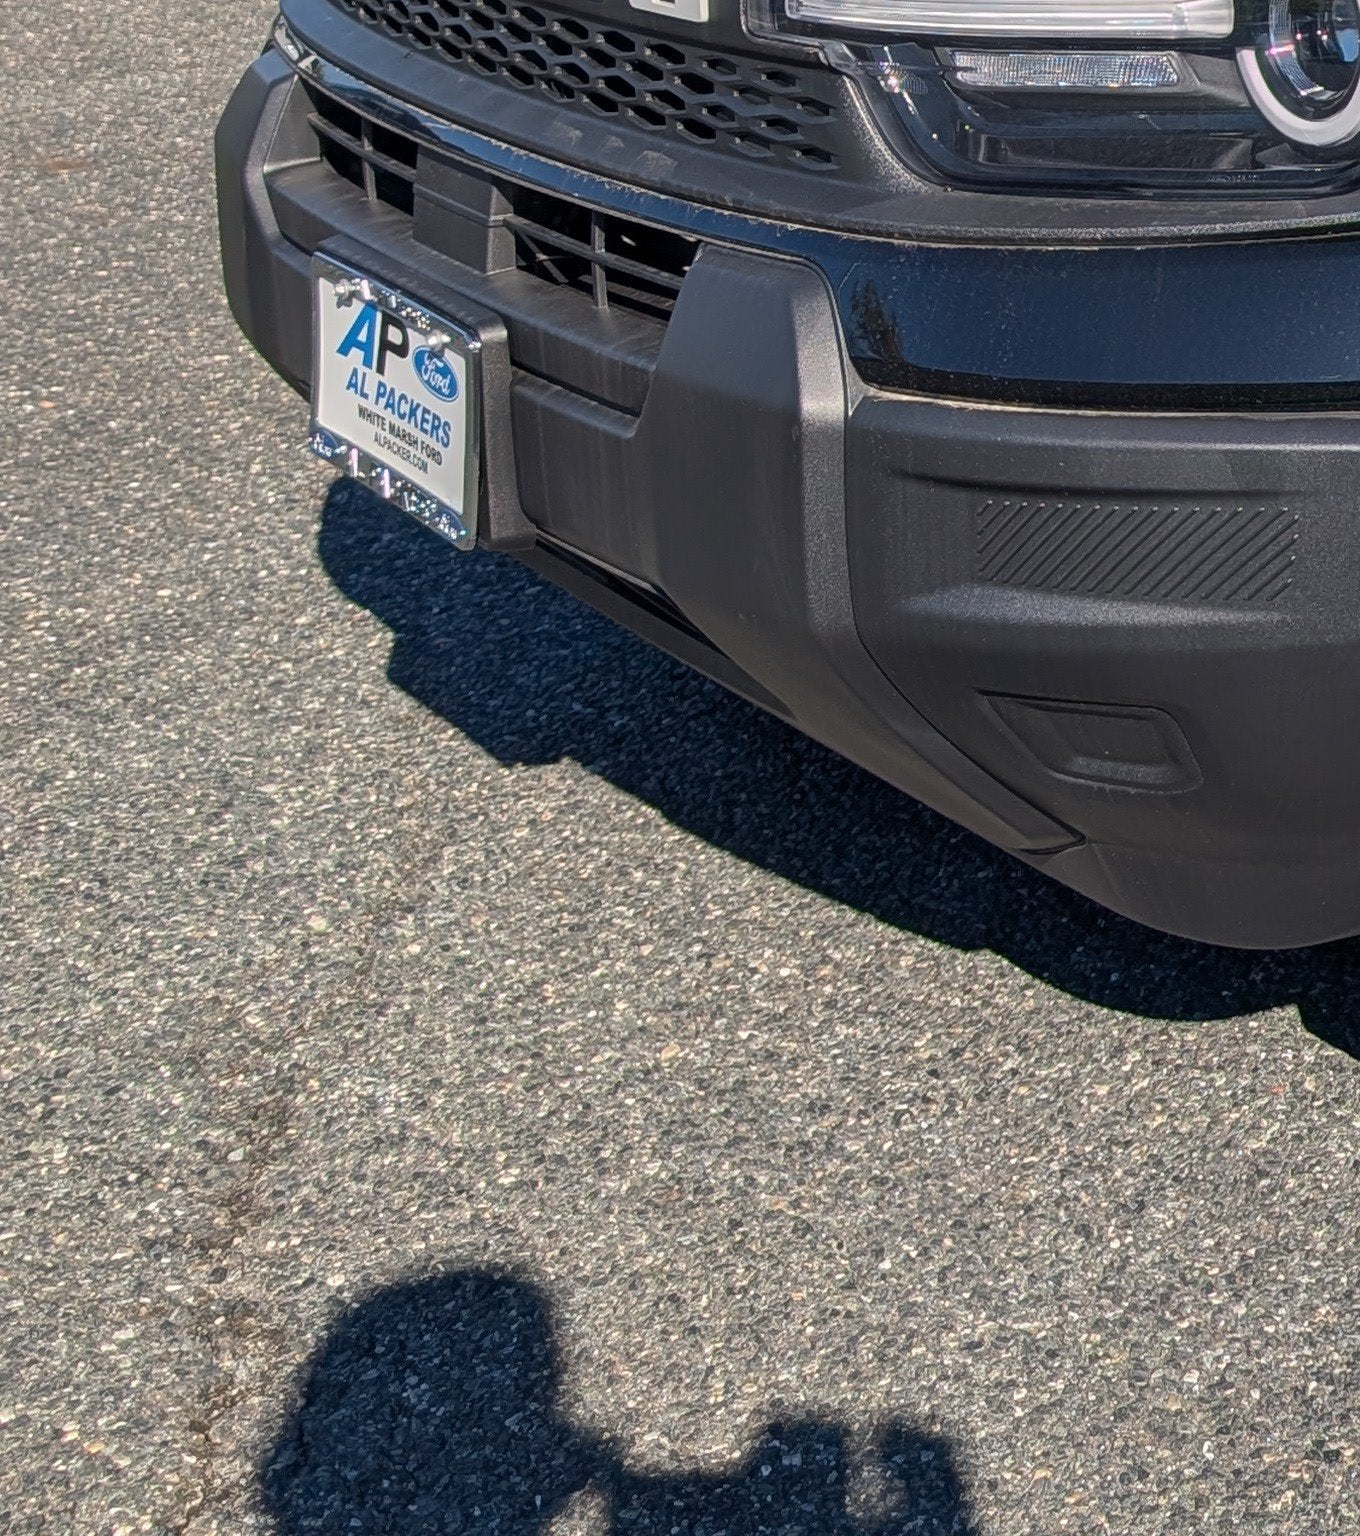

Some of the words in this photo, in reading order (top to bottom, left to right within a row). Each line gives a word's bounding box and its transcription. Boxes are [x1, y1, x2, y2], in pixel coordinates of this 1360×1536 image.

[336, 302, 410, 377] AP
[346, 367, 369, 401] AL
[374, 380, 451, 450] PACKERS
[421, 353, 457, 399] Ford
[358, 404, 387, 432] WHITE
[388, 420, 419, 454] MARSH
[420, 440, 443, 467] FORD
